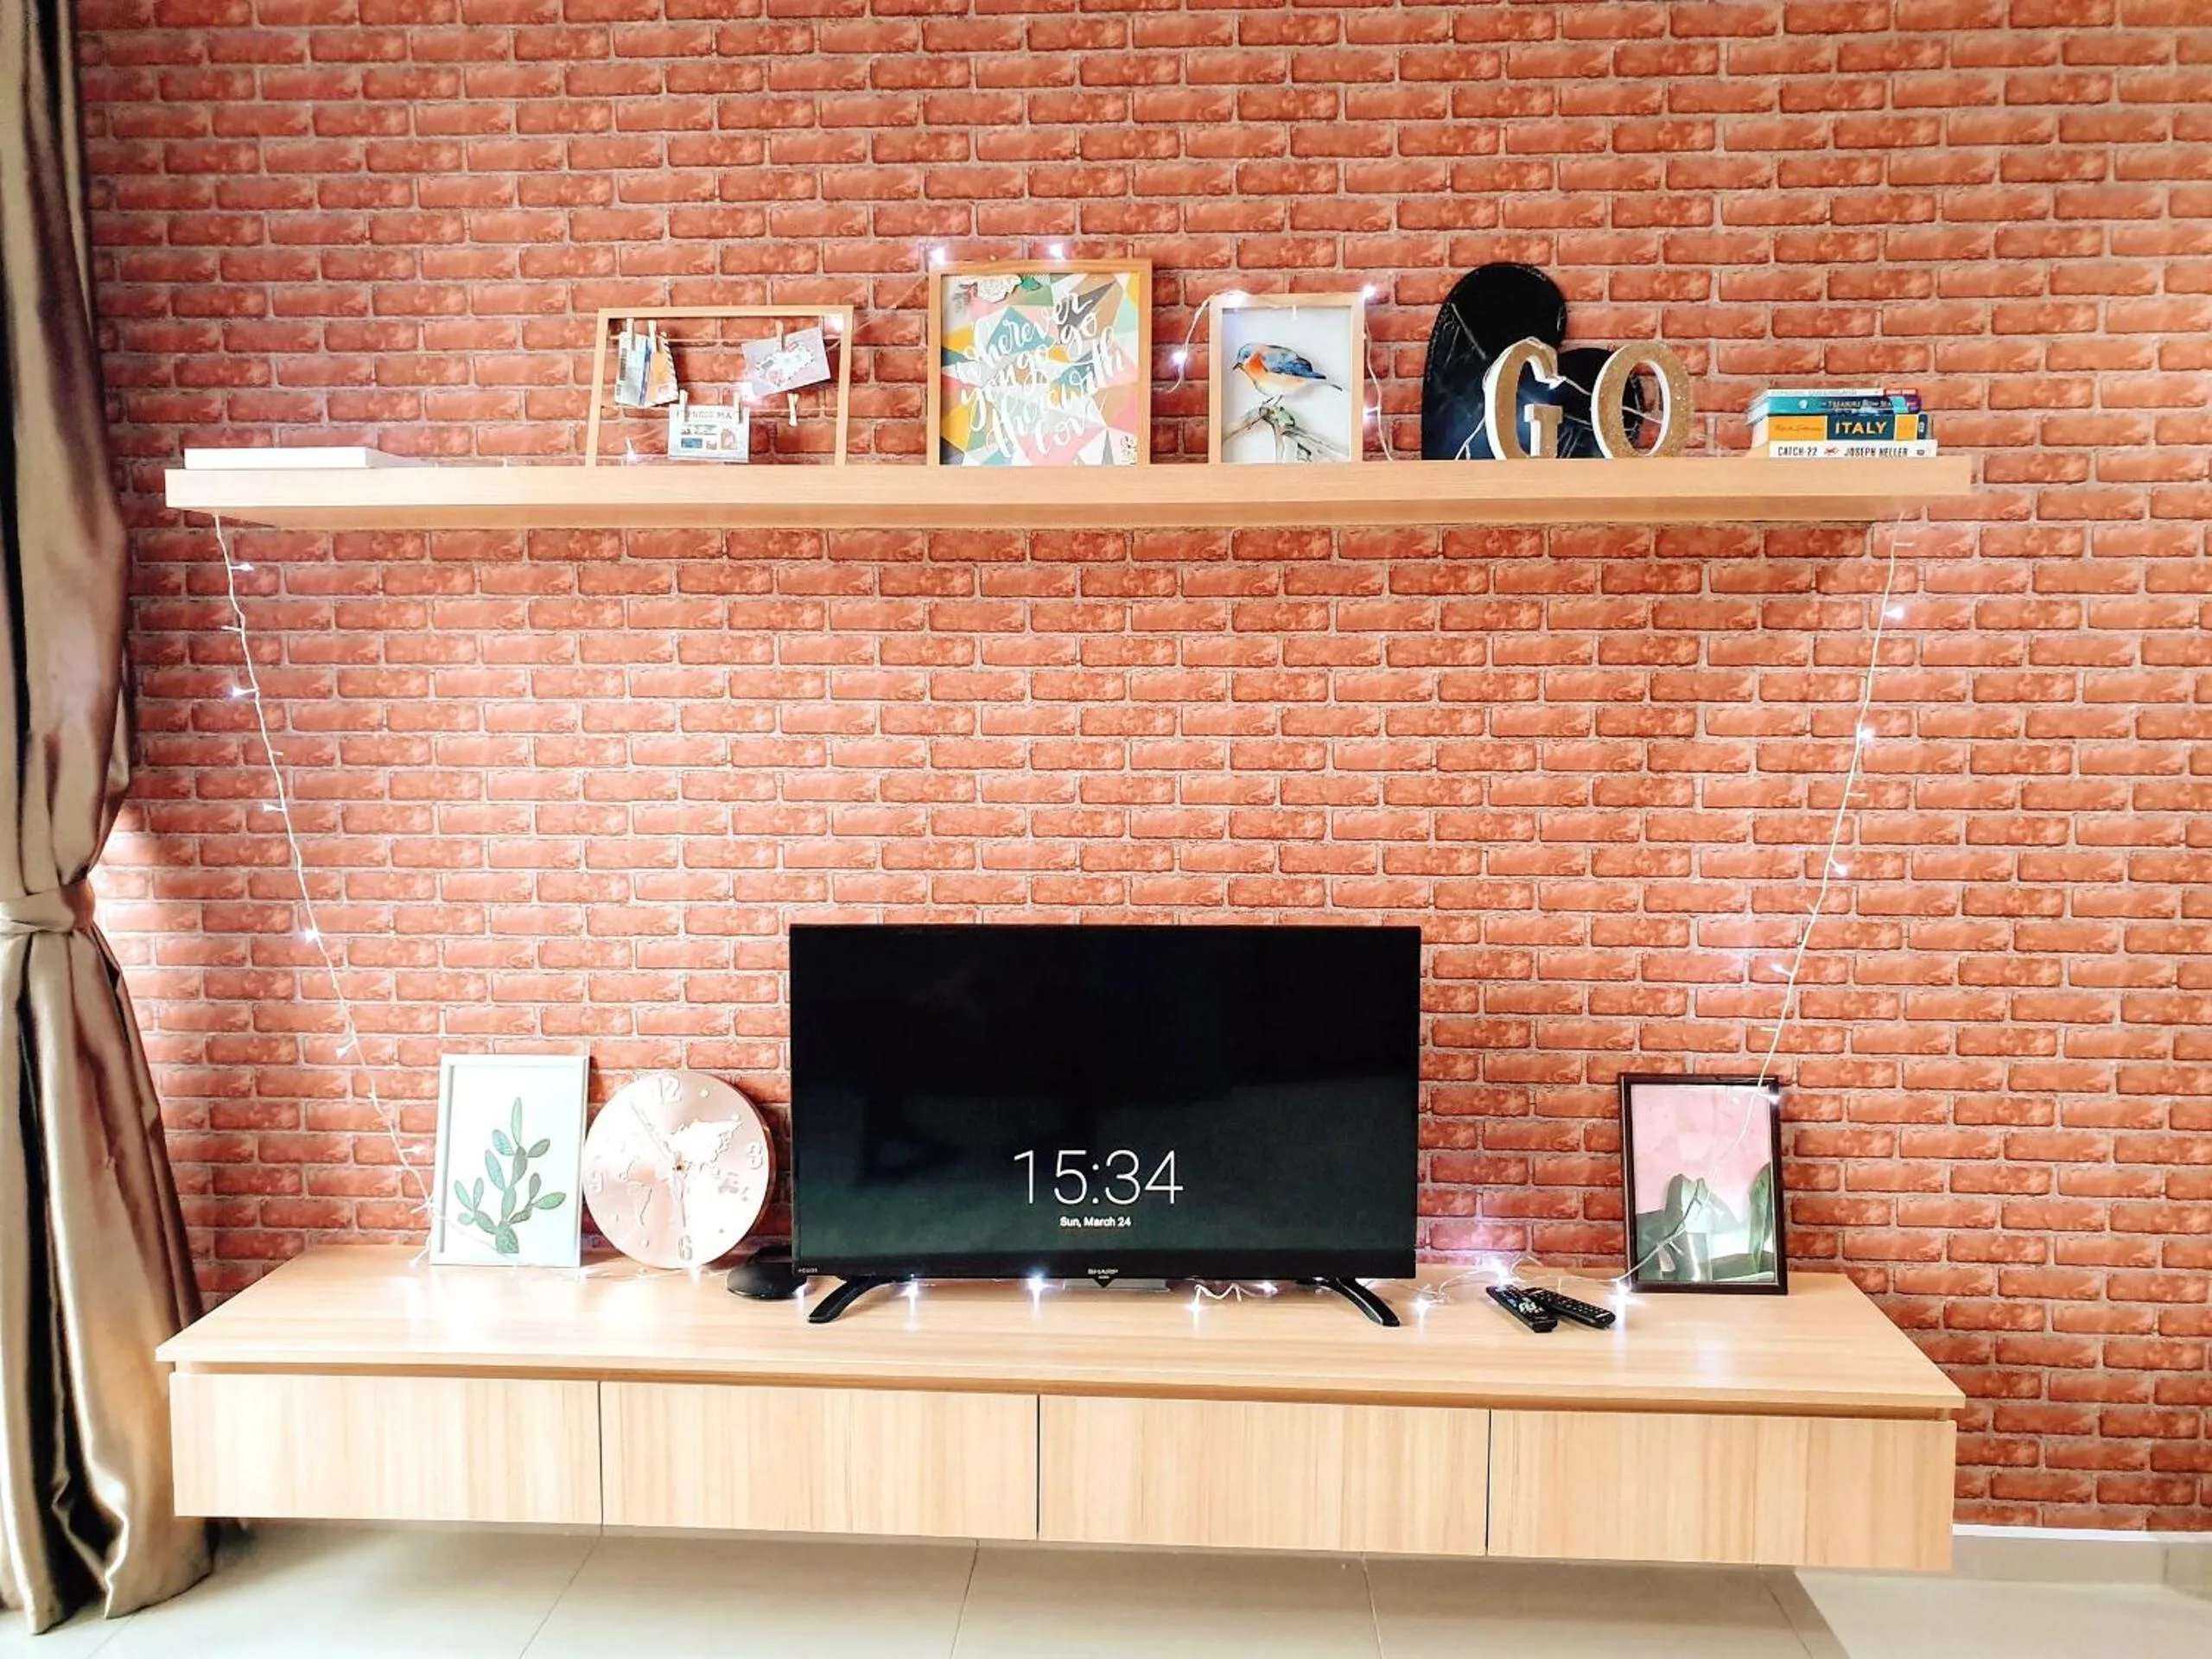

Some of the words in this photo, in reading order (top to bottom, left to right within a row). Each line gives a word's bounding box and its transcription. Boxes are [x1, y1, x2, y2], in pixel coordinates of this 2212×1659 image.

[1483, 336, 1692, 460] GO
[1834, 421, 1887, 435] ITALY
[1844, 447, 1876, 457] JOSEPH
[1879, 447, 1909, 458] HELLER
[1014, 1149, 1184, 1205] 15:34
[1059, 1216, 1081, 1227] Sun,
[1084, 1216, 1116, 1227] March
[1117, 1216, 1131, 1227] 24
